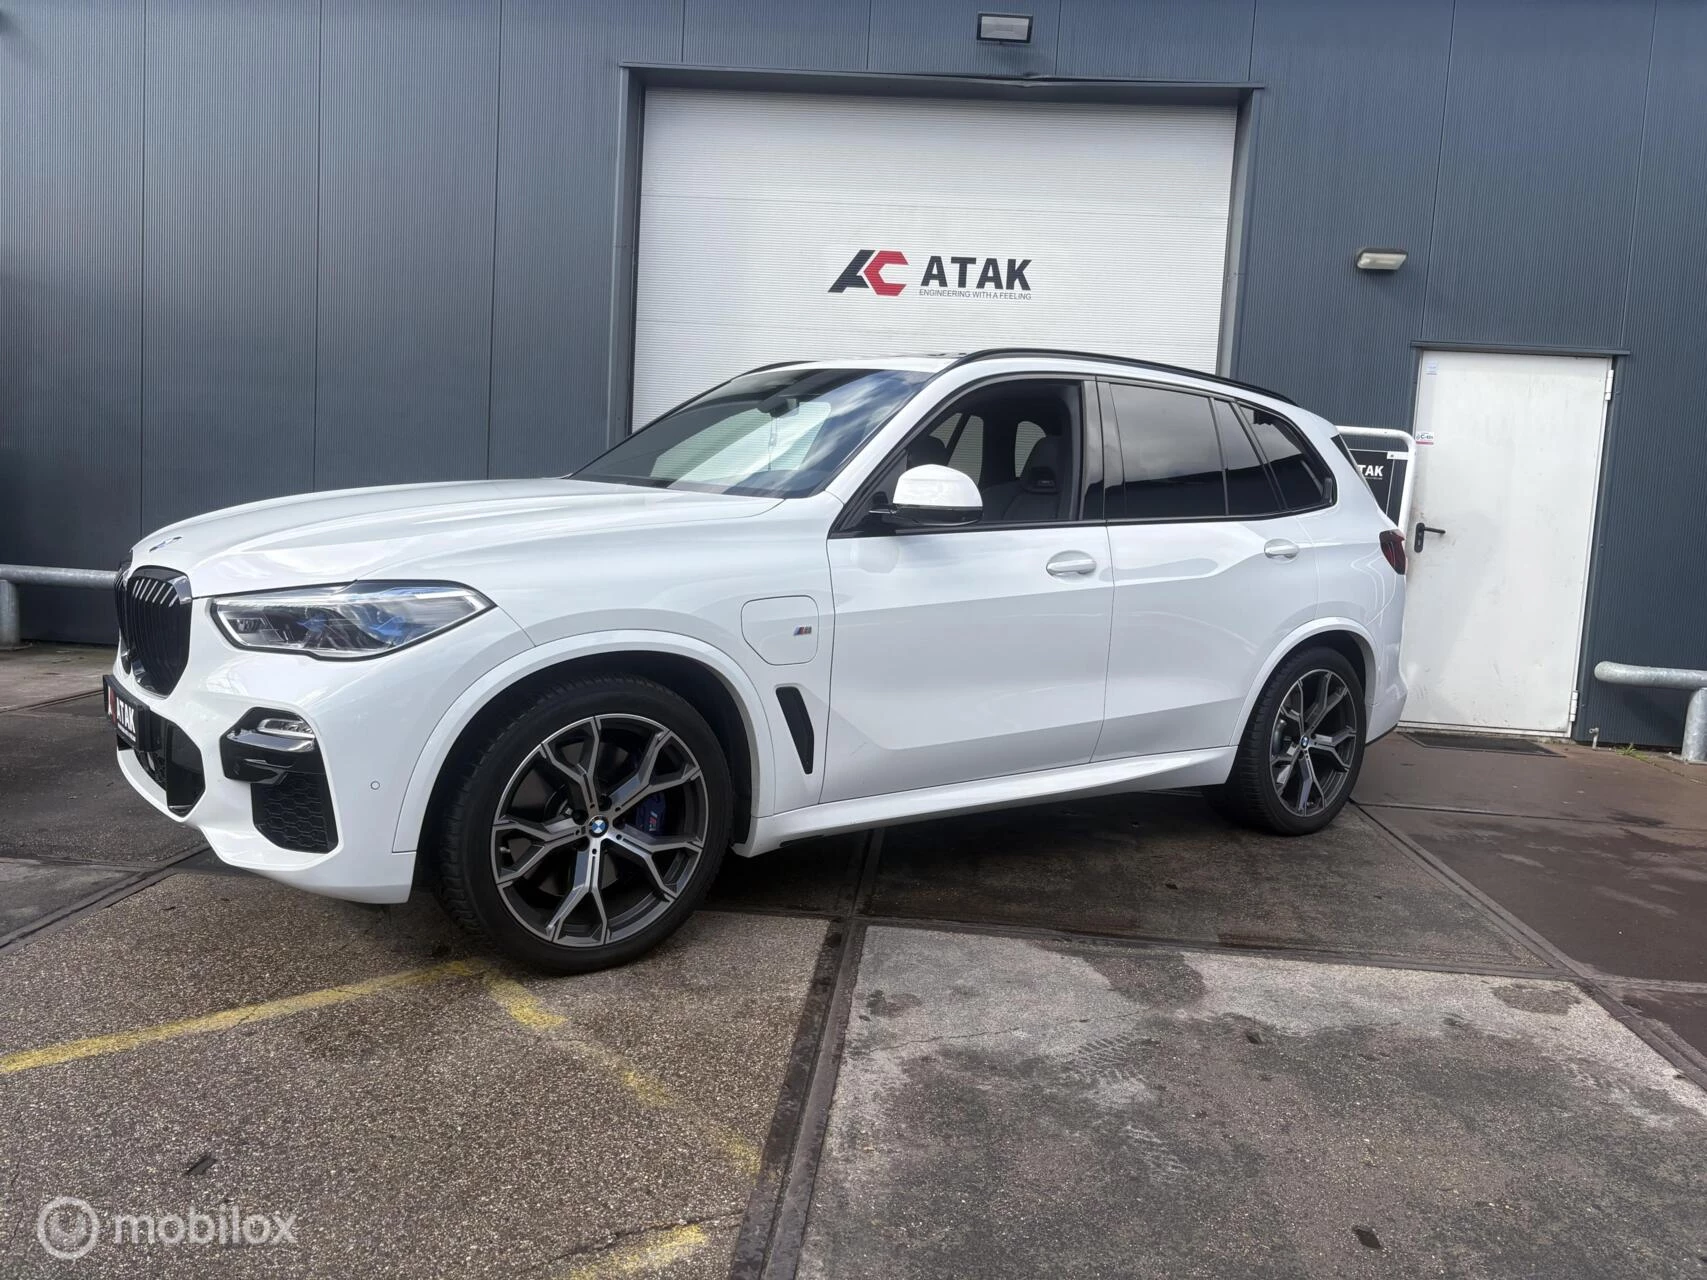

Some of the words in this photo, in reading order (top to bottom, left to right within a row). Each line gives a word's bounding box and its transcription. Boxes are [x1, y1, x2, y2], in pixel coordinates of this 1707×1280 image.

[920, 255, 1032, 291] ATAK
[919, 289, 970, 298] ENGINEERING
[972, 291, 991, 299] WITH
[1000, 292, 1031, 300] FEELING
[1357, 464, 1384, 477] TAK
